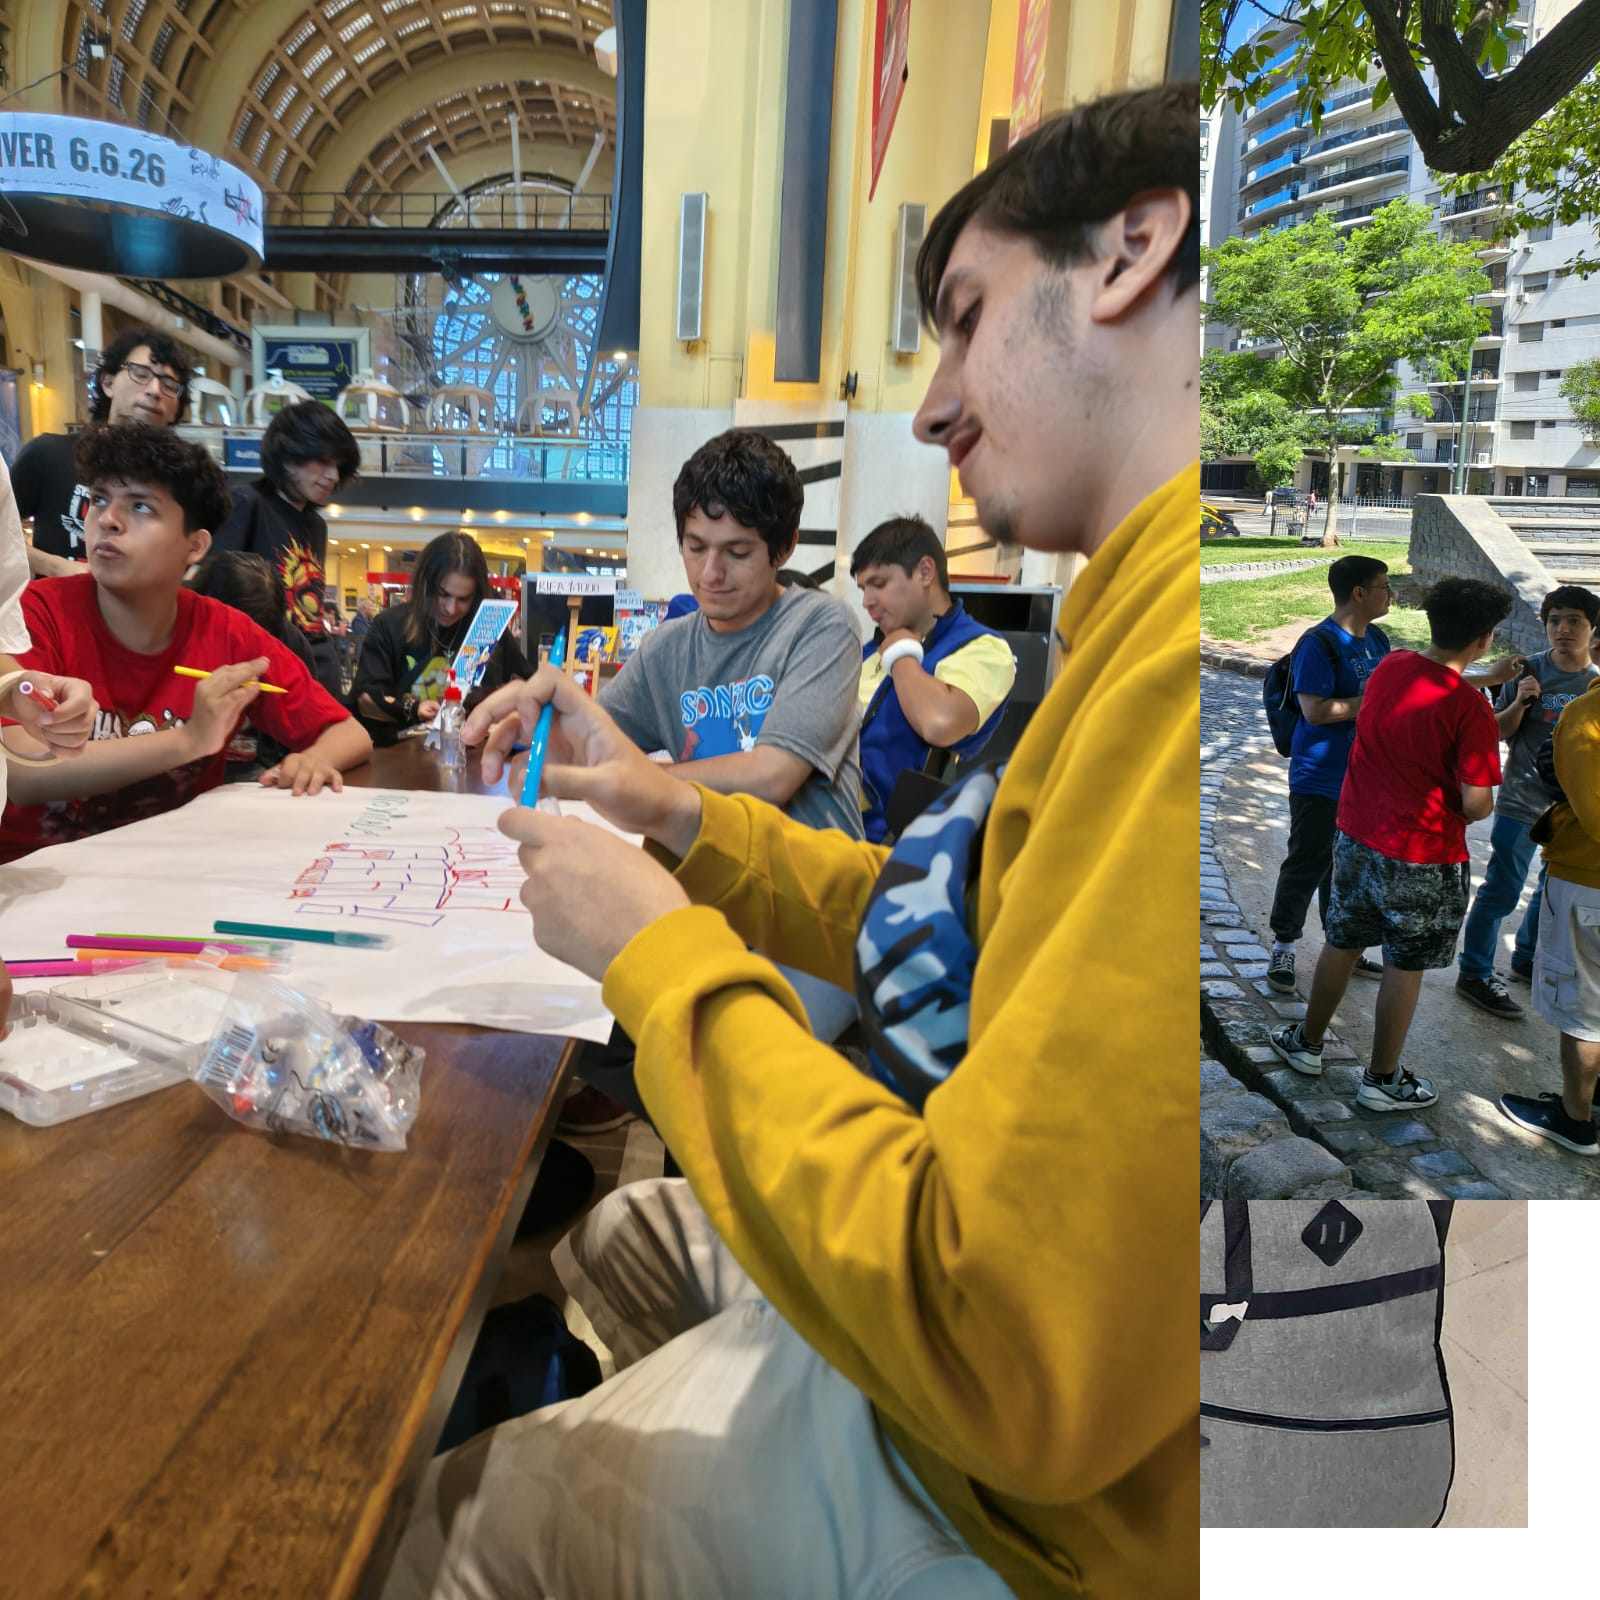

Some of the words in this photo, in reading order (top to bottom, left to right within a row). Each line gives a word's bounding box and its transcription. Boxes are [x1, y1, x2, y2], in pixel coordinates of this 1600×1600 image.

[0, 131, 57, 169] VER
[69, 136, 167, 187] 6.6.26
[680, 674, 774, 727] SONIC
